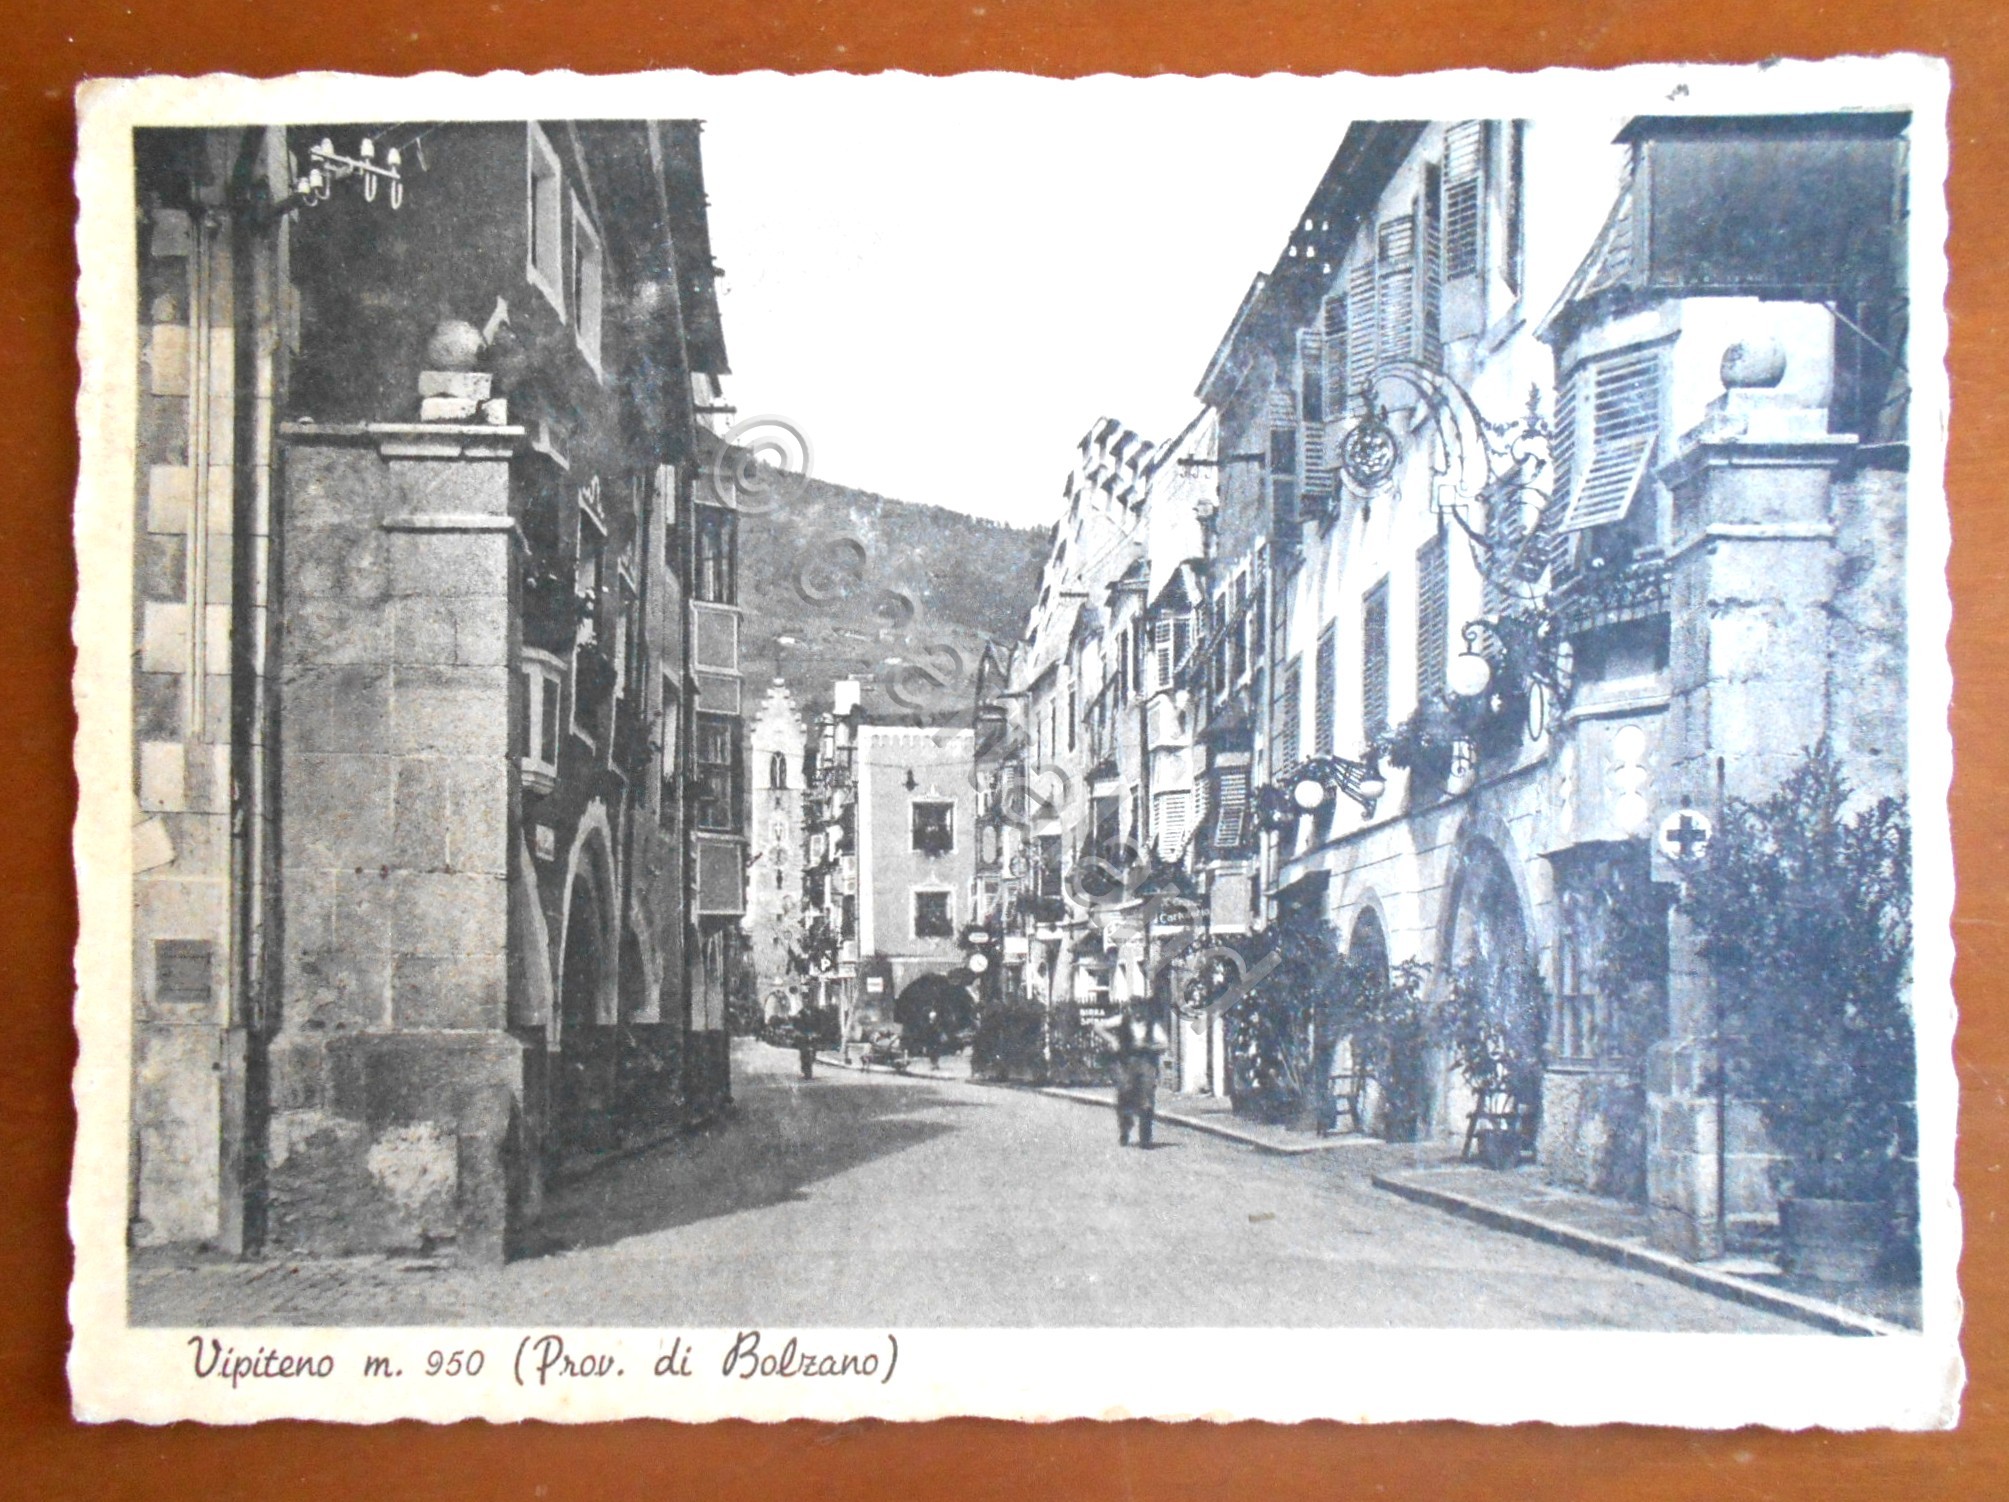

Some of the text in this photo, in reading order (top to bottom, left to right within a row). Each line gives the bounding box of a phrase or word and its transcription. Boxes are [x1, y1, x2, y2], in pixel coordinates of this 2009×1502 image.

[187, 1330, 898, 1389] Vipiteno m. 950 (Prov. di Bolzano)
